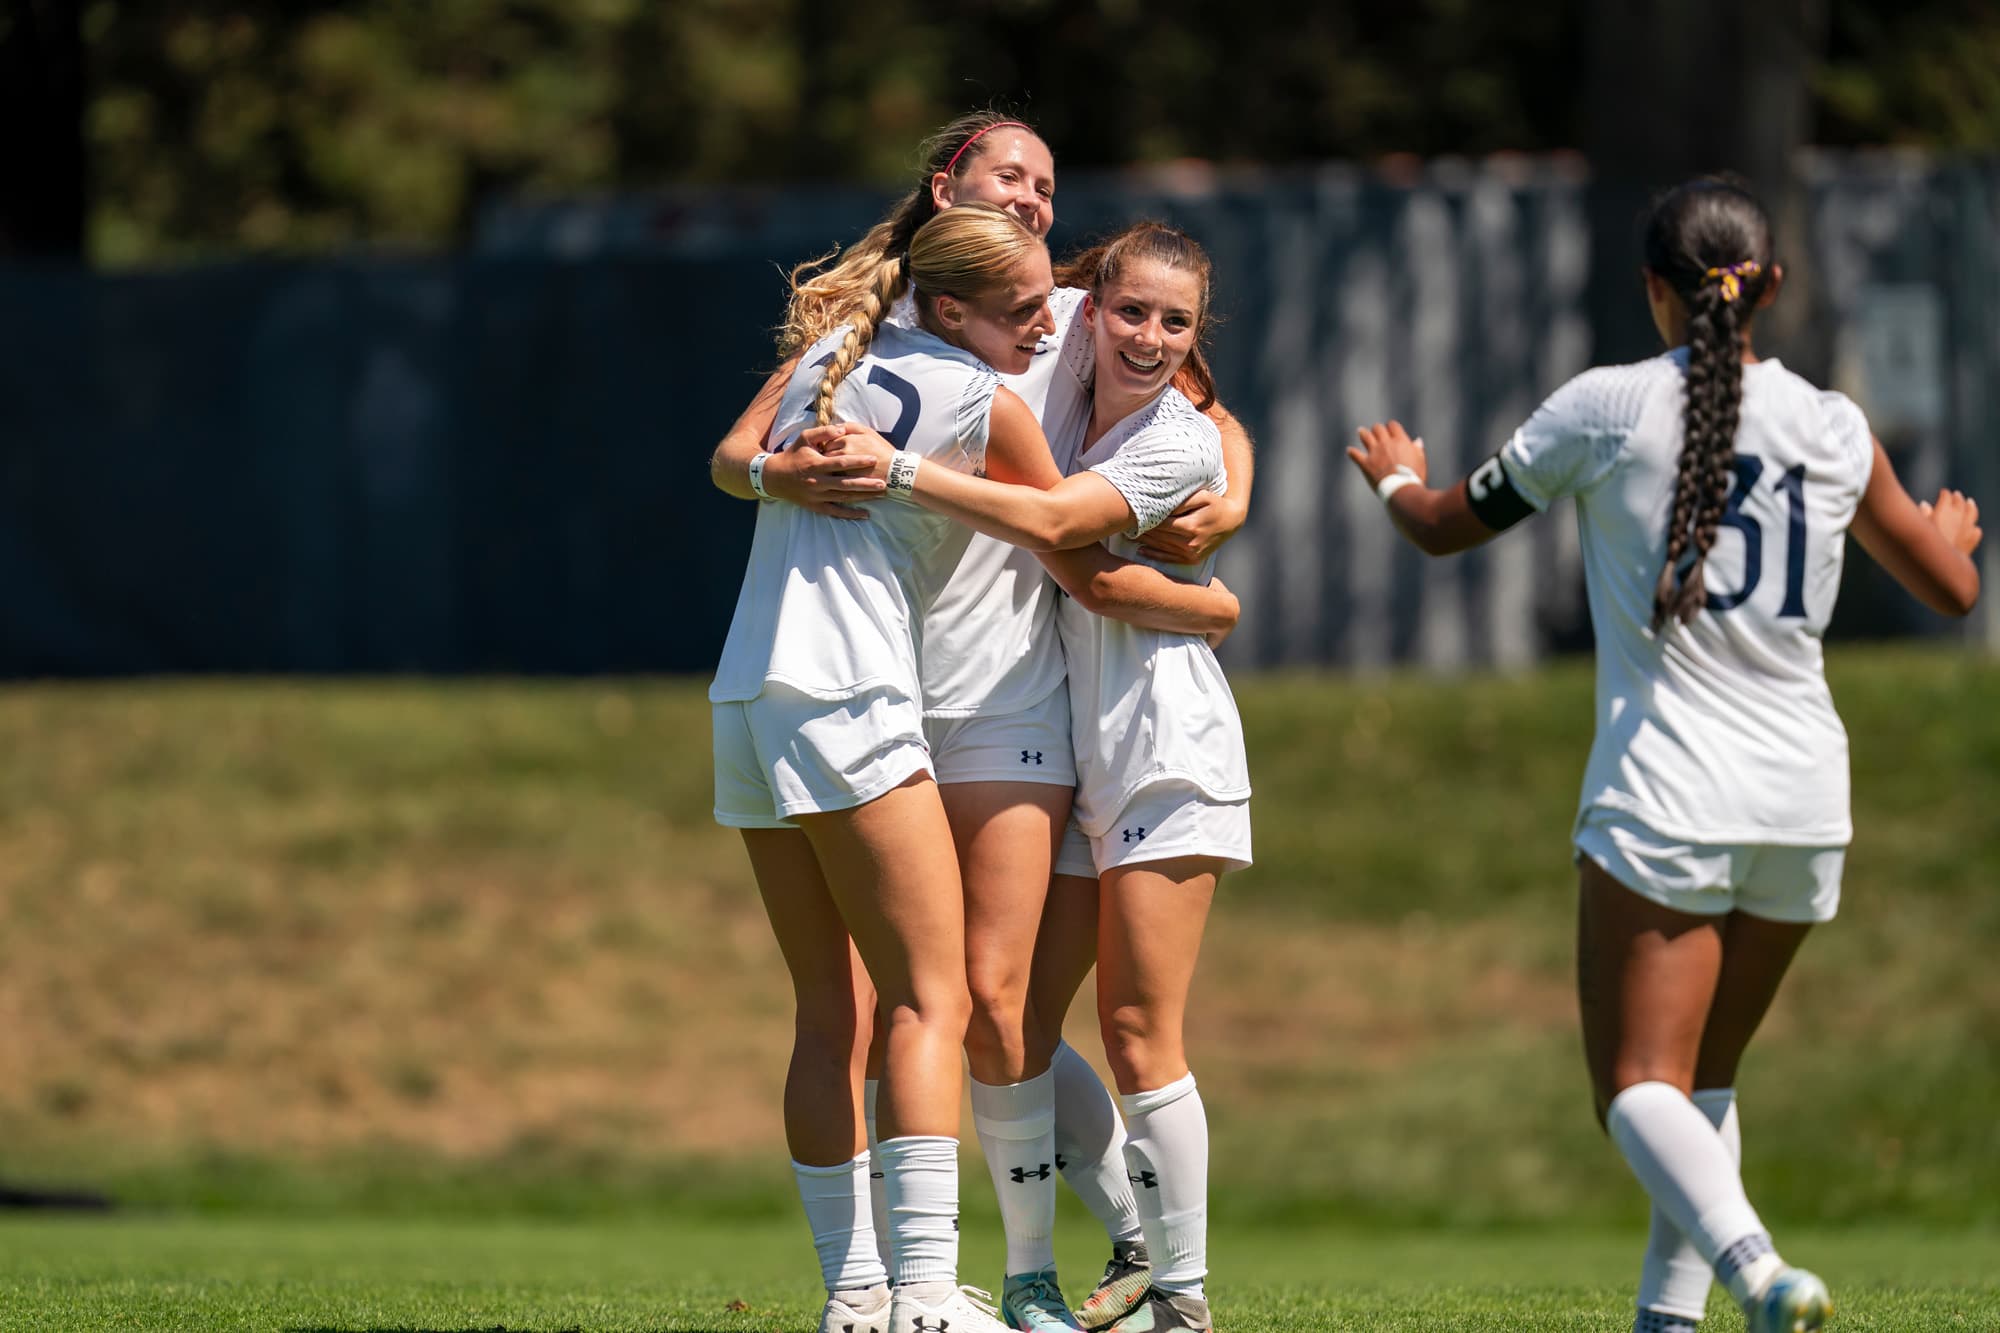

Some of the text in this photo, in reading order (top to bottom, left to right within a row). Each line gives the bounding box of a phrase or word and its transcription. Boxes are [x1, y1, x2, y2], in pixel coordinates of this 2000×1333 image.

[900, 466, 916, 490] 8:31
[1469, 456, 1504, 500] C
[1680, 454, 1808, 617] 31
